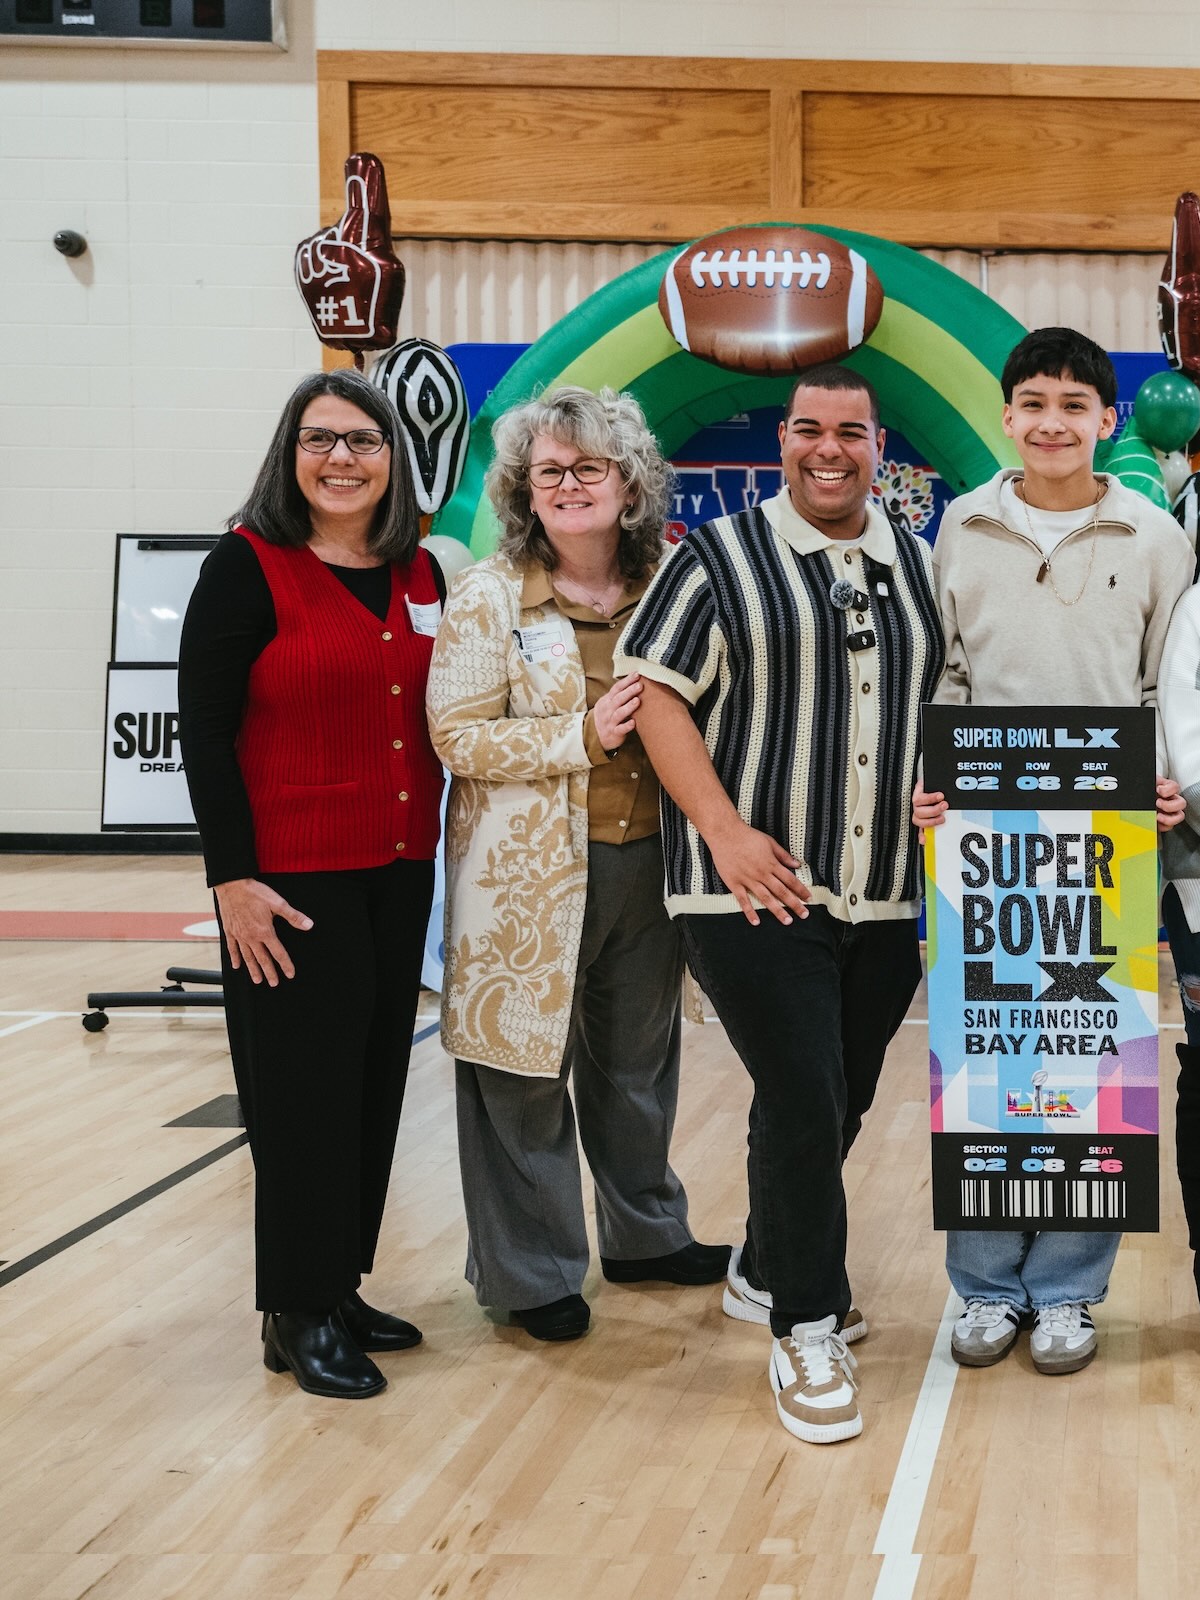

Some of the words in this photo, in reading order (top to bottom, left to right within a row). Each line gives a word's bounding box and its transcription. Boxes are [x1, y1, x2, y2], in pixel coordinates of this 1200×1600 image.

[315, 296, 365, 327] #1
[113, 712, 180, 759] SUP
[953, 727, 1003, 748] SUPER
[1007, 727, 1051, 748] BOWL
[1054, 728, 1120, 748] LX
[140, 763, 186, 772] DREA
[957, 761, 1002, 771] SECTION
[1025, 762, 1050, 771] ROW
[1082, 762, 1108, 771] SEAT
[955, 776, 999, 791] 02
[1016, 776, 1061, 791] 08
[1073, 776, 1118, 791] 26
[960, 832, 1115, 889] SUPER
[963, 893, 1117, 956] BOWL
[964, 961, 1119, 1003] LX
[964, 1008, 1000, 1029] SAN
[1010, 1008, 1118, 1030] FRANCISCO
[965, 1033, 1028, 1055] BAY
[1033, 1034, 1119, 1056] AREA
[963, 1145, 1007, 1154] SECTION
[1031, 1146, 1055, 1154] ROW
[1088, 1146, 1114, 1155] SEAT
[963, 1157, 1007, 1172] 02
[1021, 1158, 1065, 1173] 08
[1079, 1158, 1123, 1173] 26
